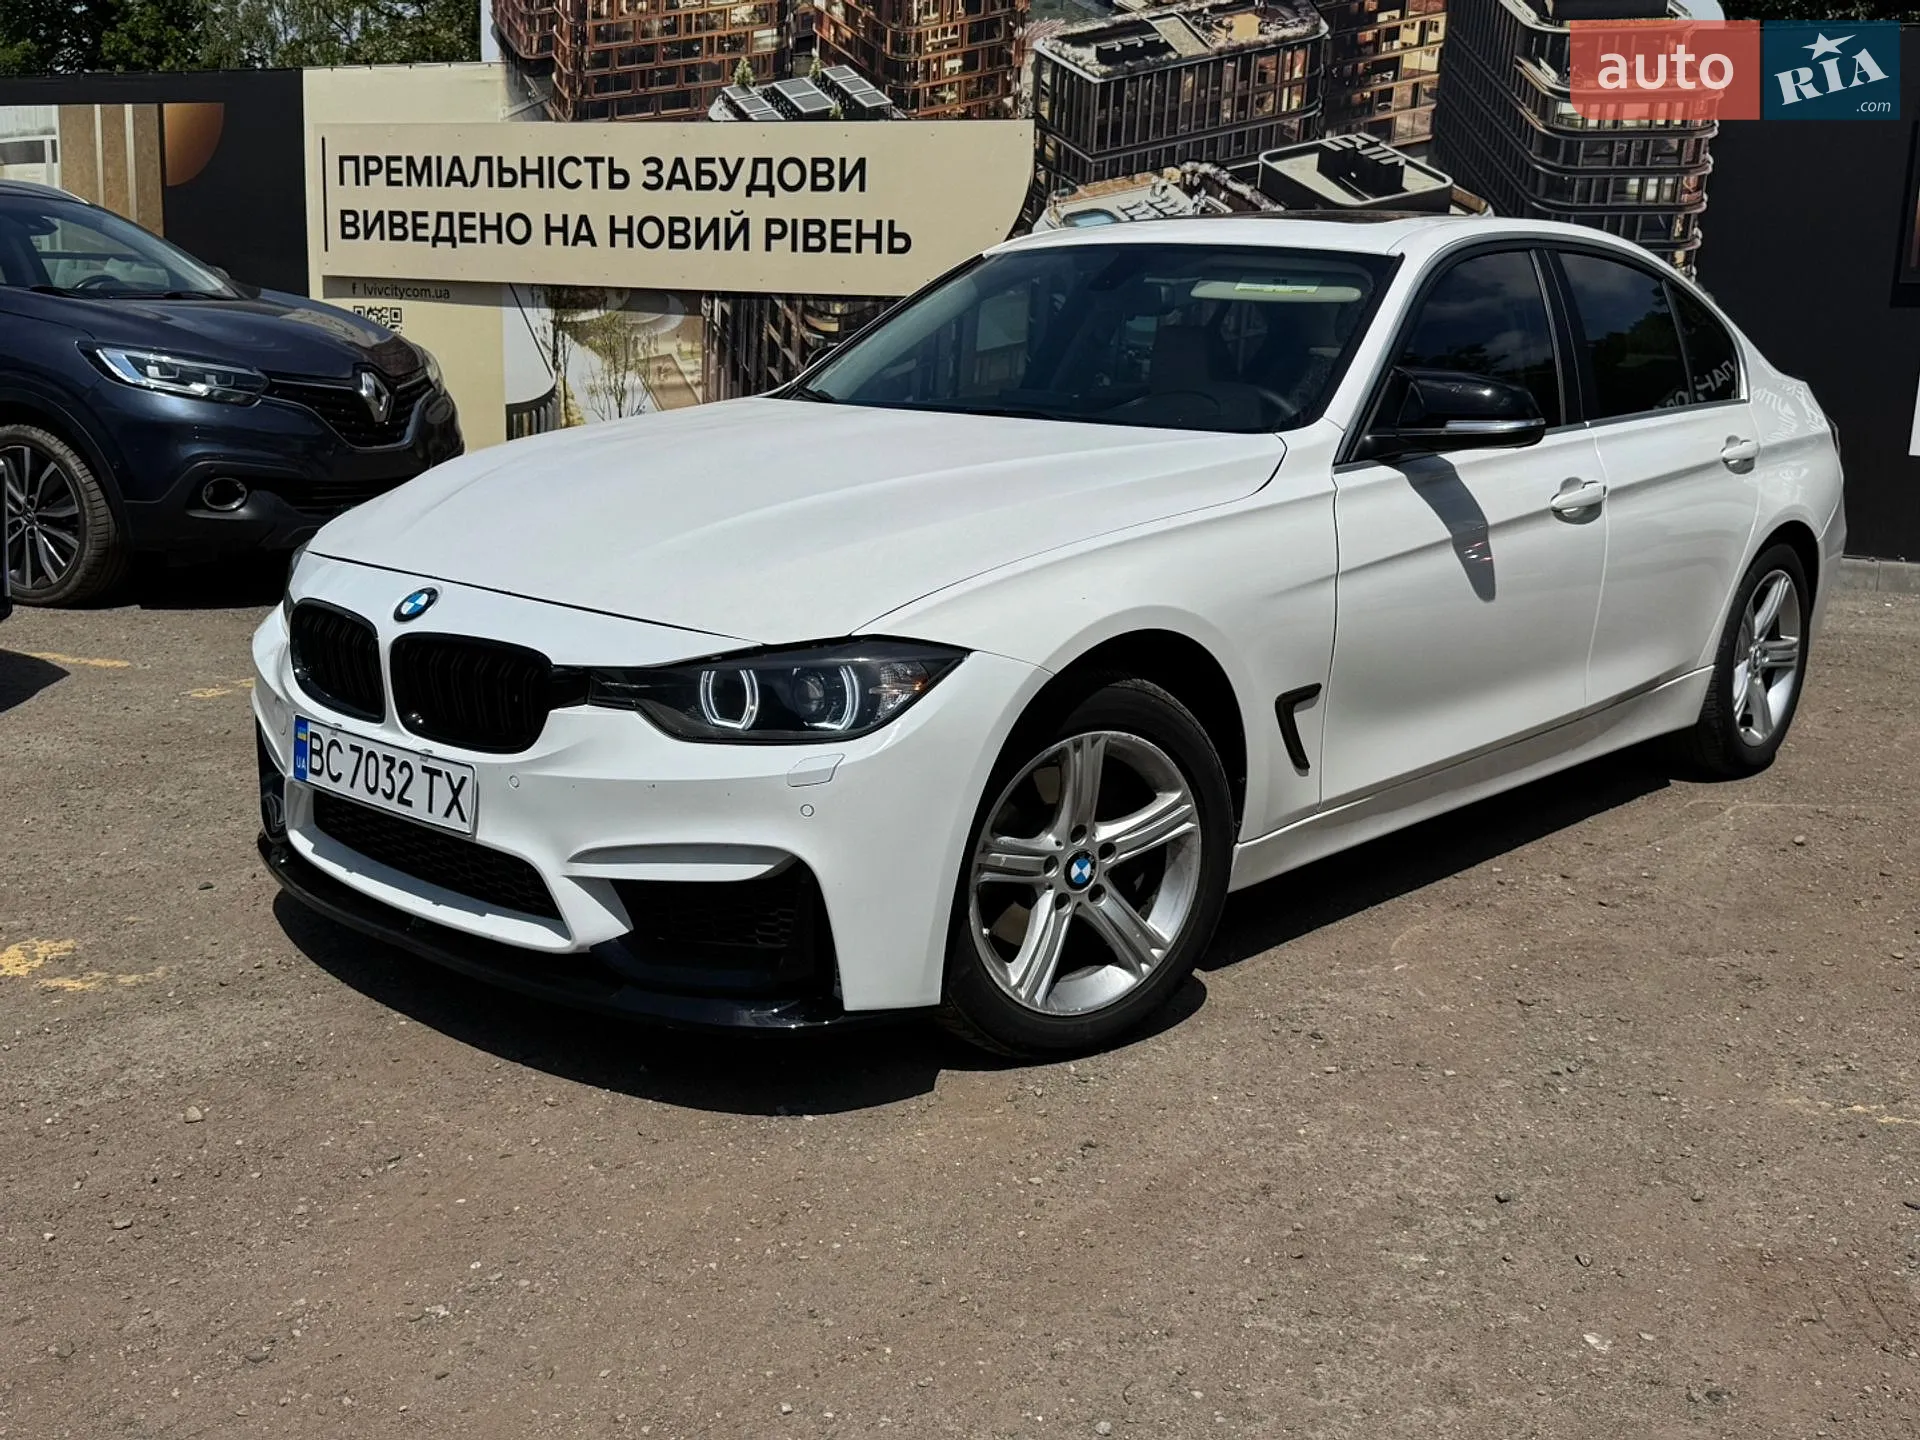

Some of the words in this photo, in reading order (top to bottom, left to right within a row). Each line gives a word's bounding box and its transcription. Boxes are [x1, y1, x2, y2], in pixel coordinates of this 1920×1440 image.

[338, 155, 631, 191] ПРЕМІАЛЬНІСТЬ
[641, 156, 867, 199] ЗАБУДОВИ
[339, 209, 532, 249] ВИВЕДЕНО
[544, 213, 598, 248] НА
[609, 209, 750, 252] НОВИЙ
[764, 217, 912, 255] РІВЕНЬ
[296, 758, 307, 770] UA
[309, 731, 344, 783] BC
[349, 744, 415, 808] 7032
[421, 765, 468, 823] TX
